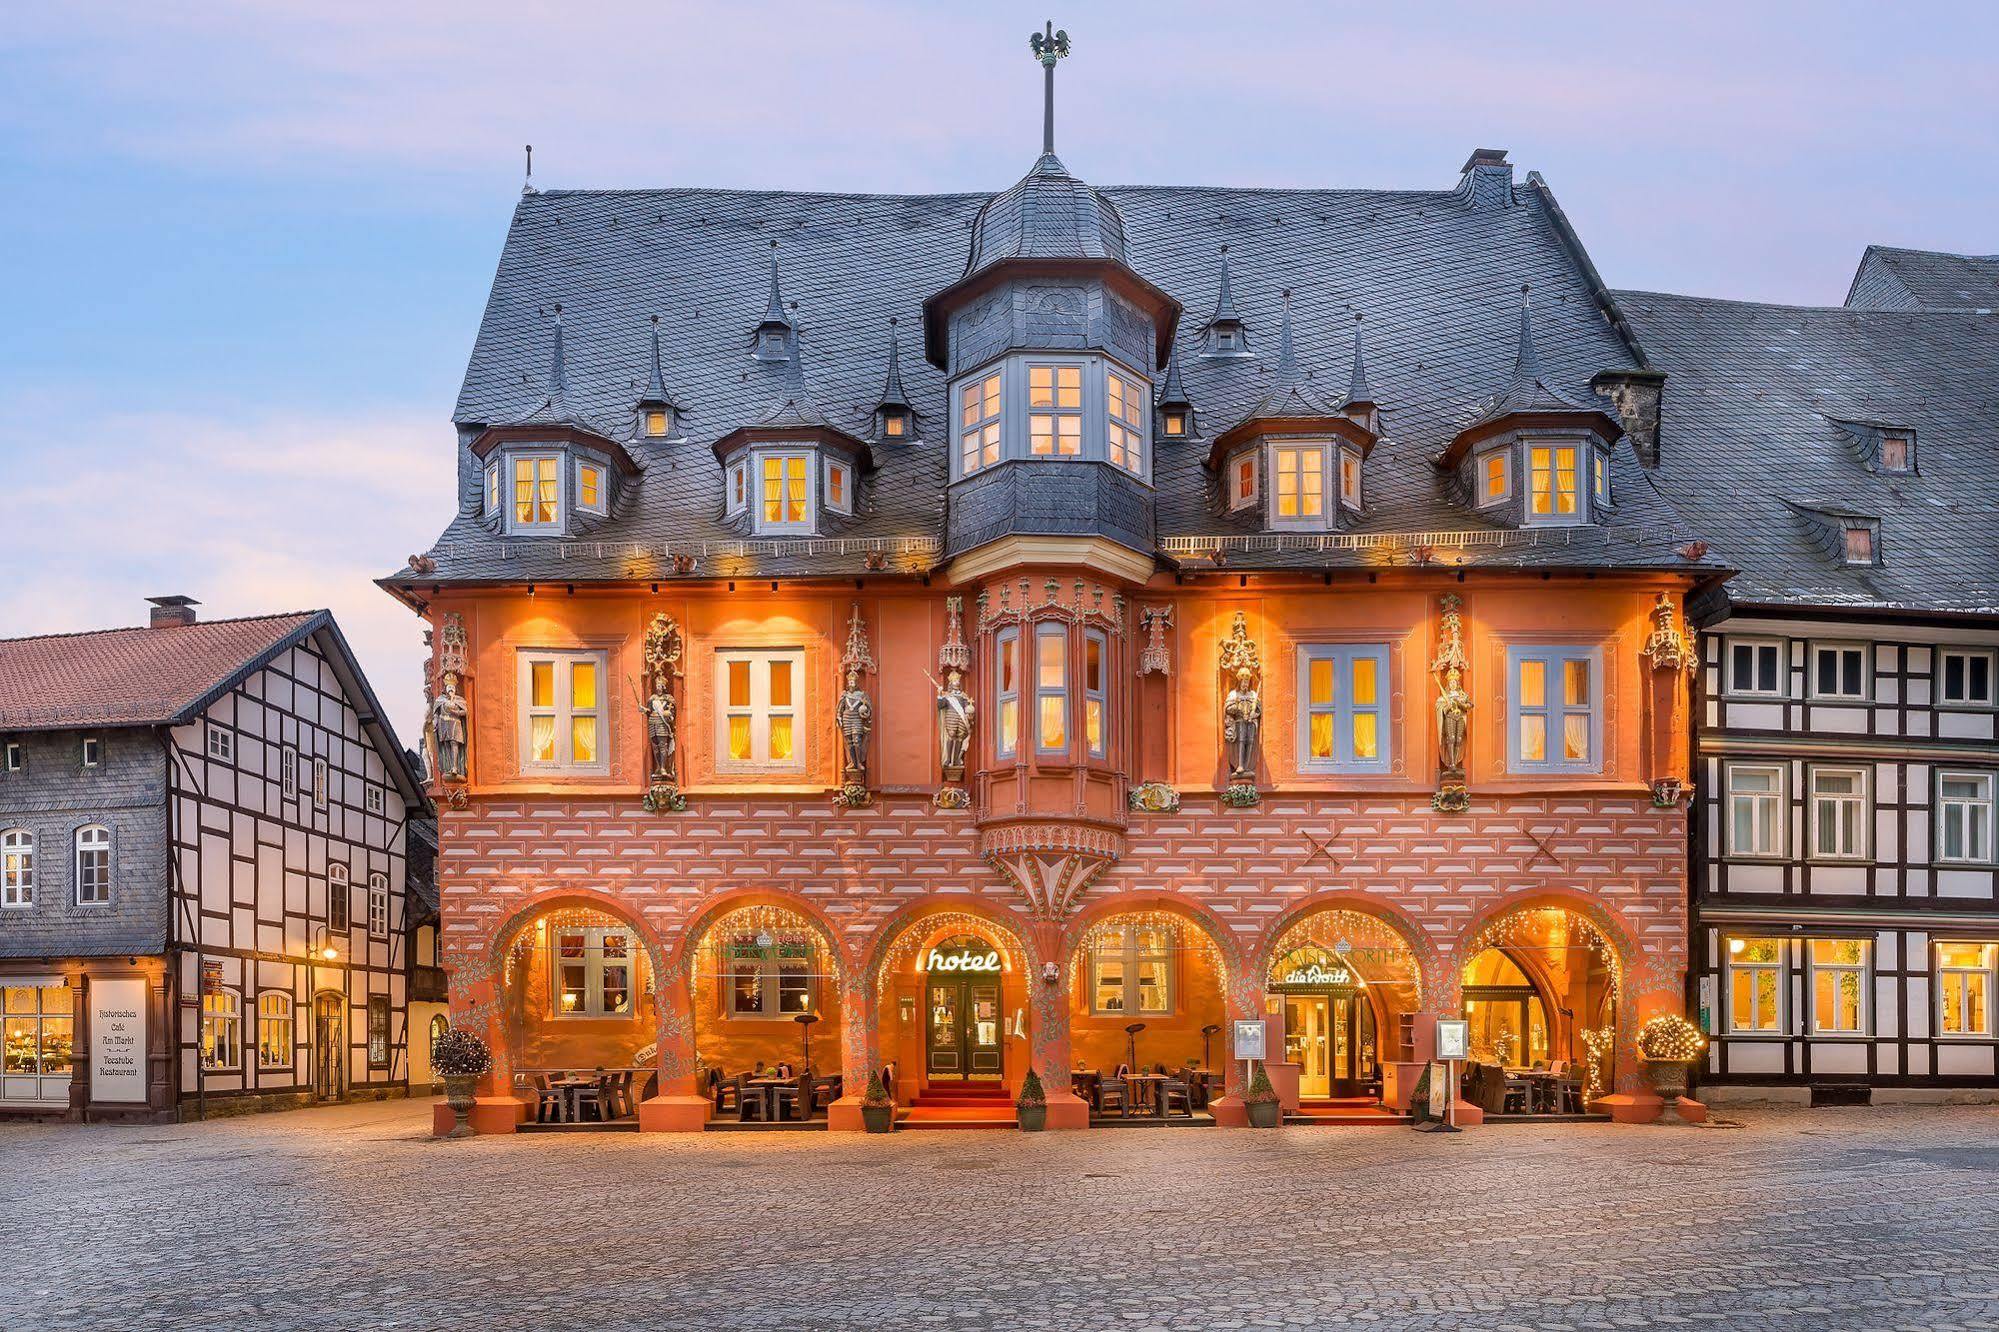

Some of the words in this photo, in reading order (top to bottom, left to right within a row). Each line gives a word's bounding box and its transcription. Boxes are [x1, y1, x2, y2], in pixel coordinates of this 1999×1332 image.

[927, 949, 1001, 971] hotel
[1285, 968, 1306, 983] die
[1306, 965, 1350, 984] Worth
[99, 1010, 137, 1019] Historisches
[102, 1036, 113, 1045] Am
[115, 1036, 134, 1045] Markt
[104, 1056, 134, 1064] Teestube
[100, 1067, 137, 1076] Restaurant
